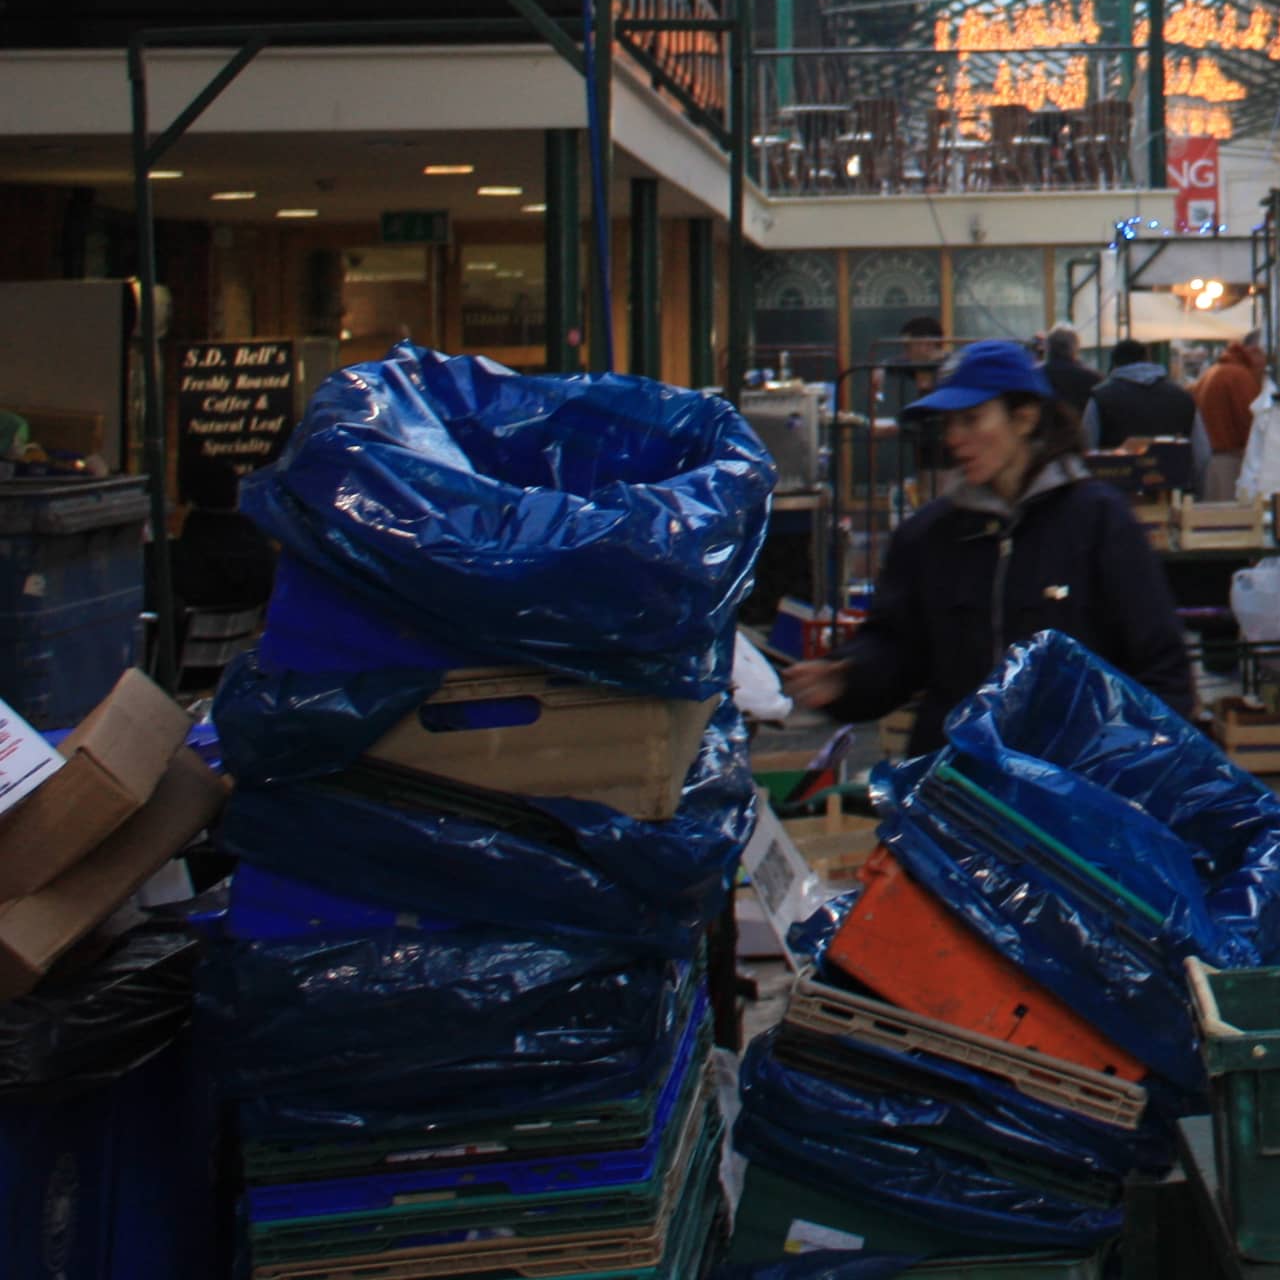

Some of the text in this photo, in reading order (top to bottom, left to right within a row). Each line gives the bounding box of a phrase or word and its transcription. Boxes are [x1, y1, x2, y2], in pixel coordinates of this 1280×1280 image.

[182, 345, 287, 368] S.D. Bell's
[180, 373, 290, 392] Freshly Roasted
[202, 394, 269, 413] Coffee &
[188, 416, 286, 433] Natural Leaf
[203, 439, 273, 456] Speciality
